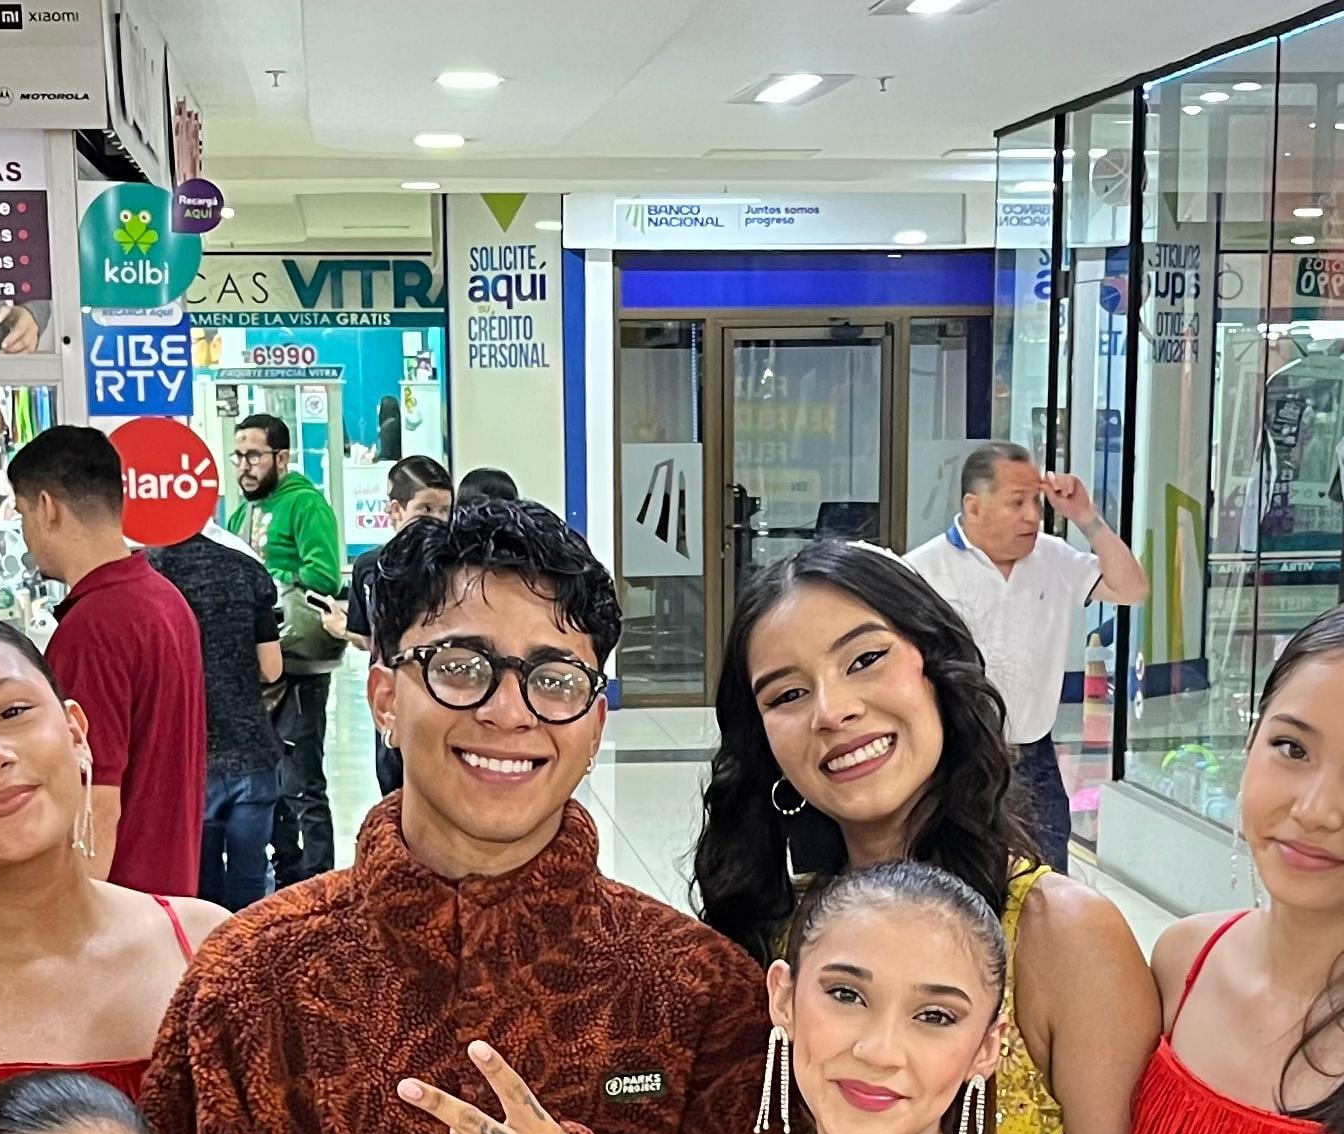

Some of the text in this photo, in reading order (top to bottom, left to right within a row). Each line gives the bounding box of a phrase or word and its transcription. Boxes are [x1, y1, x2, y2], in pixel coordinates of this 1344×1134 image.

[28, 10, 79, 23] xiaomi
[19, 92, 90, 101] MOTOROLA
[647, 205, 700, 216] BANCO
[744, 205, 820, 215] Juntos somos
[647, 217, 725, 227] NACIONAL
[744, 217, 795, 228] progreso
[469, 244, 537, 272] SOLICITE
[104, 257, 169, 285] kölbi
[468, 261, 547, 310] aquí
[239, 313, 259, 326] DE
[264, 313, 284, 326] LA
[288, 313, 331, 326] VISTA
[336, 313, 391, 327] GRATIS
[468, 310, 533, 341] CRÉDITO
[90, 334, 189, 367] LIBE
[469, 343, 550, 369] PERSONAL
[308, 369, 338, 378] VITRA
[95, 369, 186, 402] RTY
